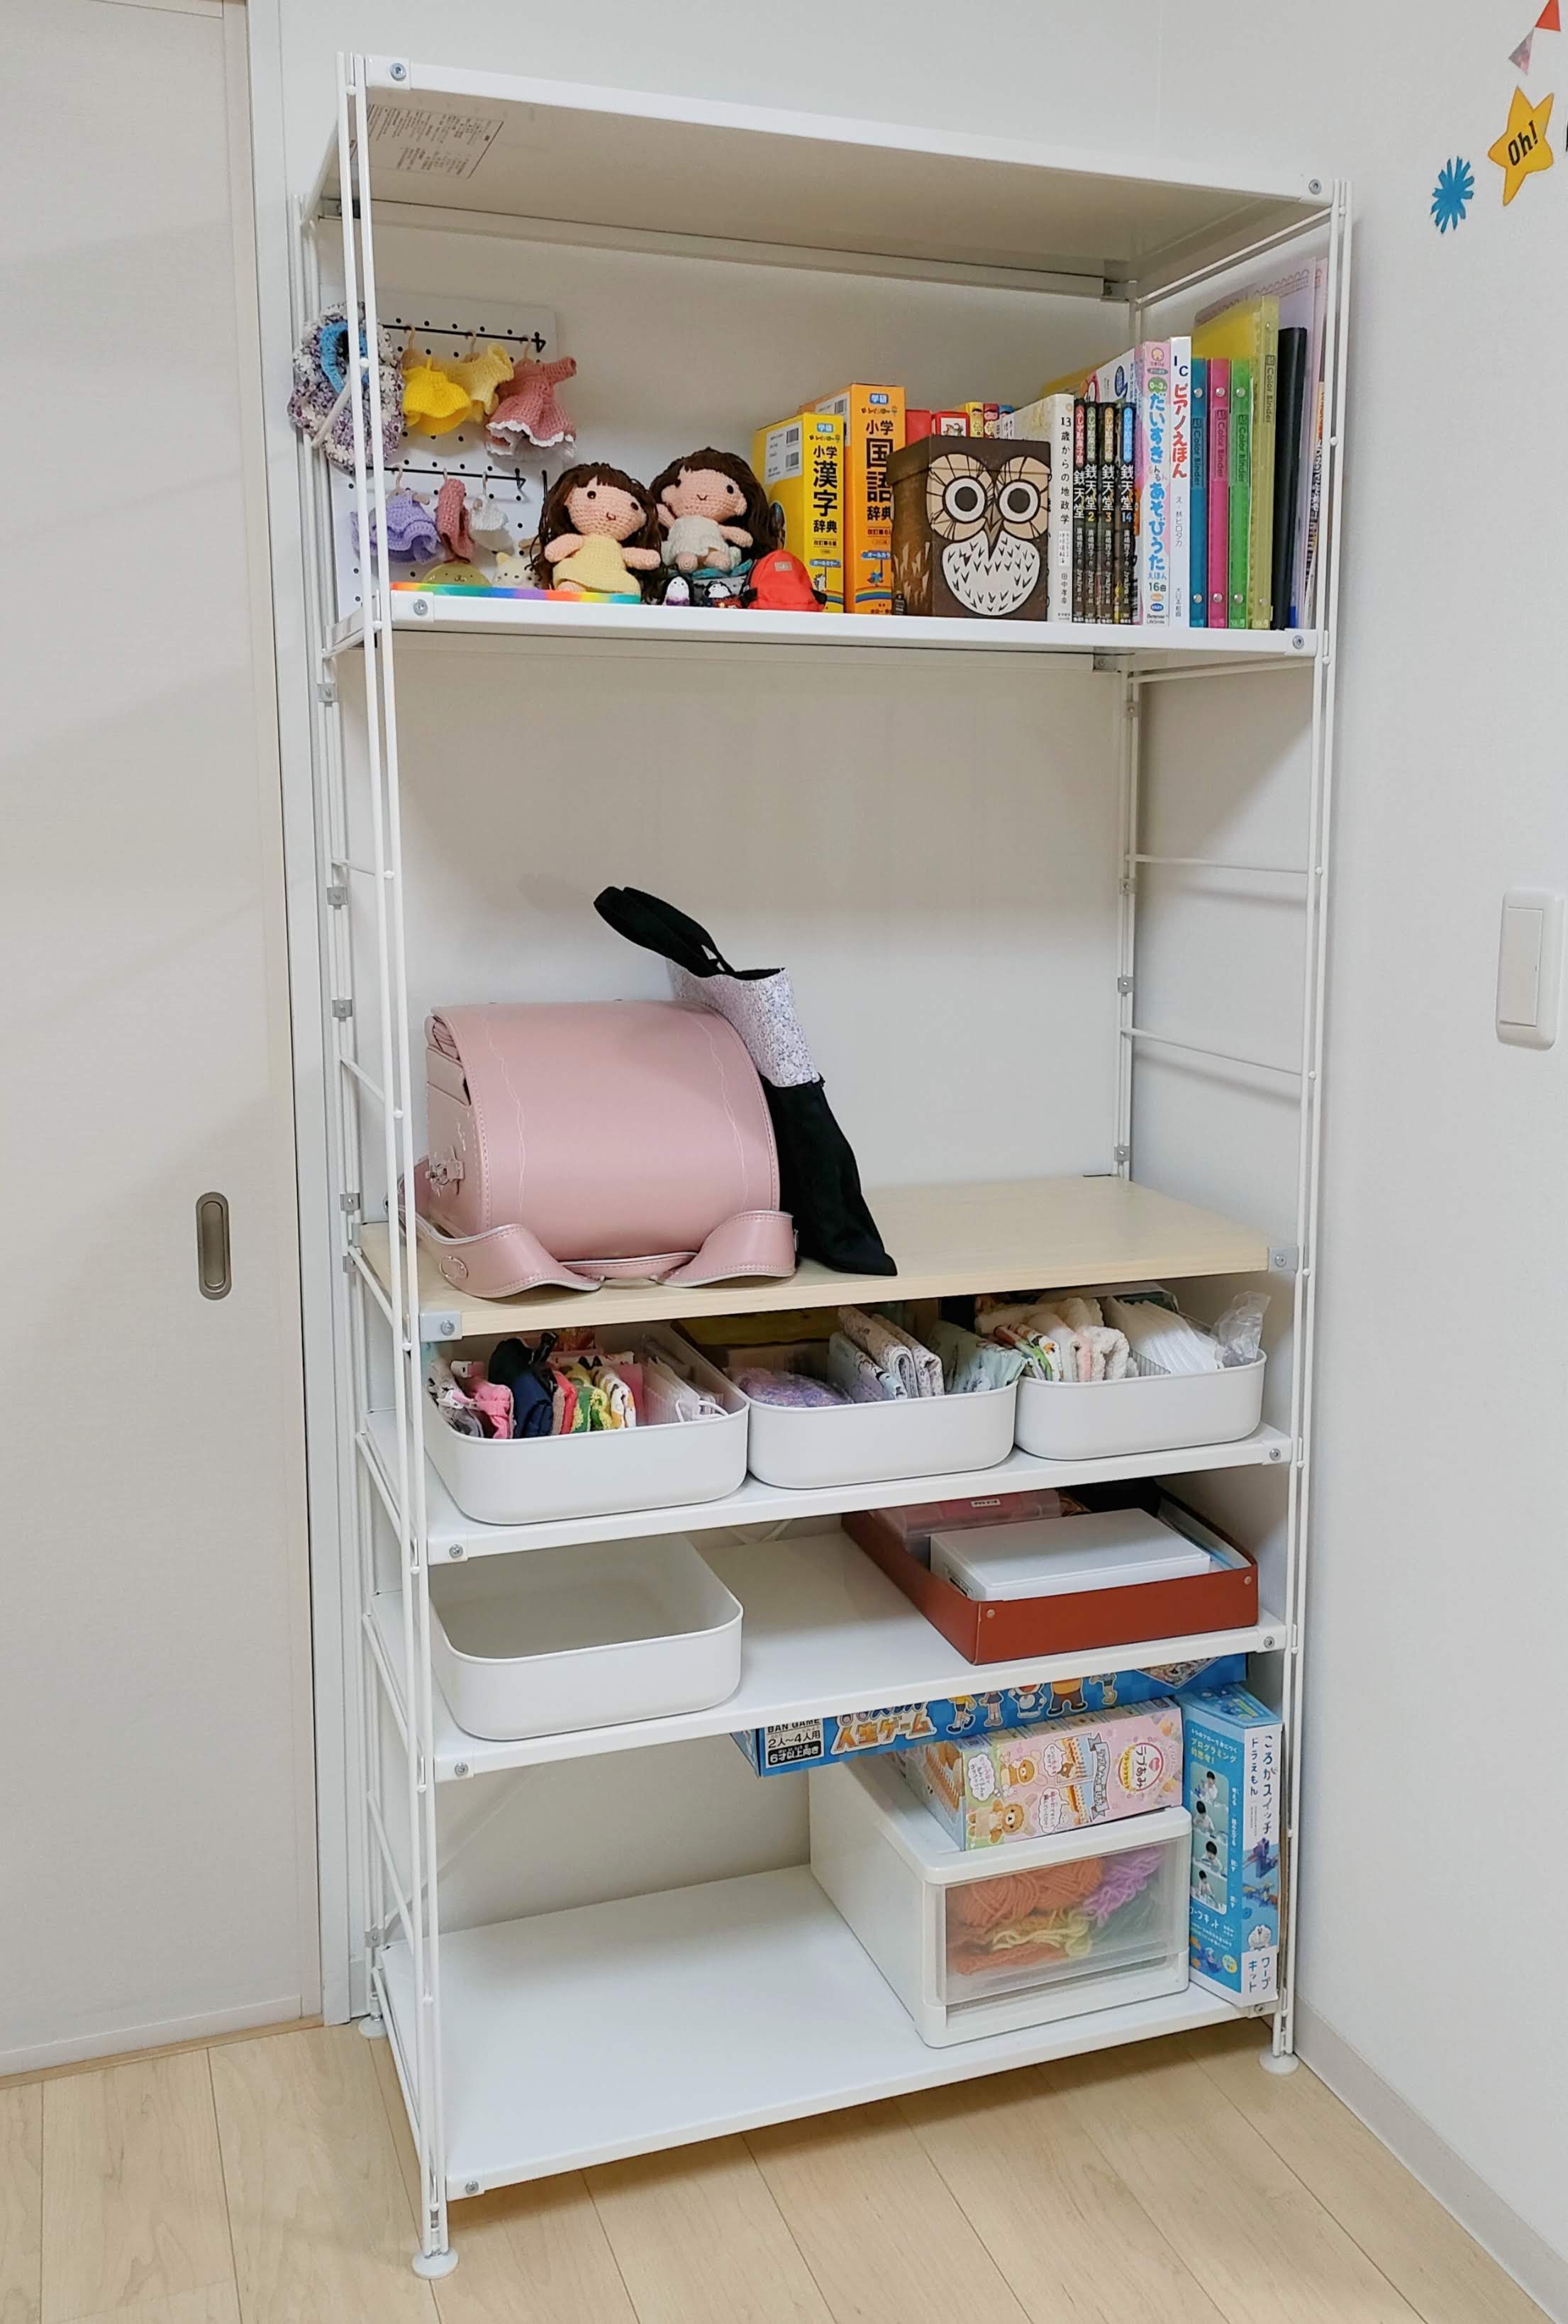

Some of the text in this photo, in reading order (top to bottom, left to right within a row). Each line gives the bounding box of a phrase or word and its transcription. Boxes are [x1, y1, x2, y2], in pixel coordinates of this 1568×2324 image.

[1508, 119, 1538, 166] Oh!
[866, 420, 894, 435] 小学
[1149, 392, 1166, 465] だいすき
[1172, 383, 1189, 479] ピアノえほん
[813, 445, 838, 458] 小学
[866, 438, 894, 503] 国語
[1060, 417, 1072, 524] 13歳からの地政学
[813, 460, 838, 517] 漢字
[813, 520, 838, 533] 辞典
[867, 506, 891, 521] 辞典
[1088, 511, 1095, 521] 2
[1106, 512, 1112, 522] 3
[1122, 512, 1133, 522] 14
[1148, 482, 1165, 571] あそびうた
[1147, 572, 1167, 581] えほん
[1149, 582, 1167, 591] 16曲
[767, 1723, 789, 1733] BAN
[834, 1713, 934, 1752] 人生ゲーム
[1135, 1745, 1147, 1789] ラブあみ
[1191, 1738, 1238, 1764] プログラミング
[1250, 1737, 1259, 1796] ドラえもん
[1262, 1735, 1279, 1835] ころがスイッチ
[1248, 1959, 1257, 1993] キット
[1262, 1956, 1271, 1990] ワープ
